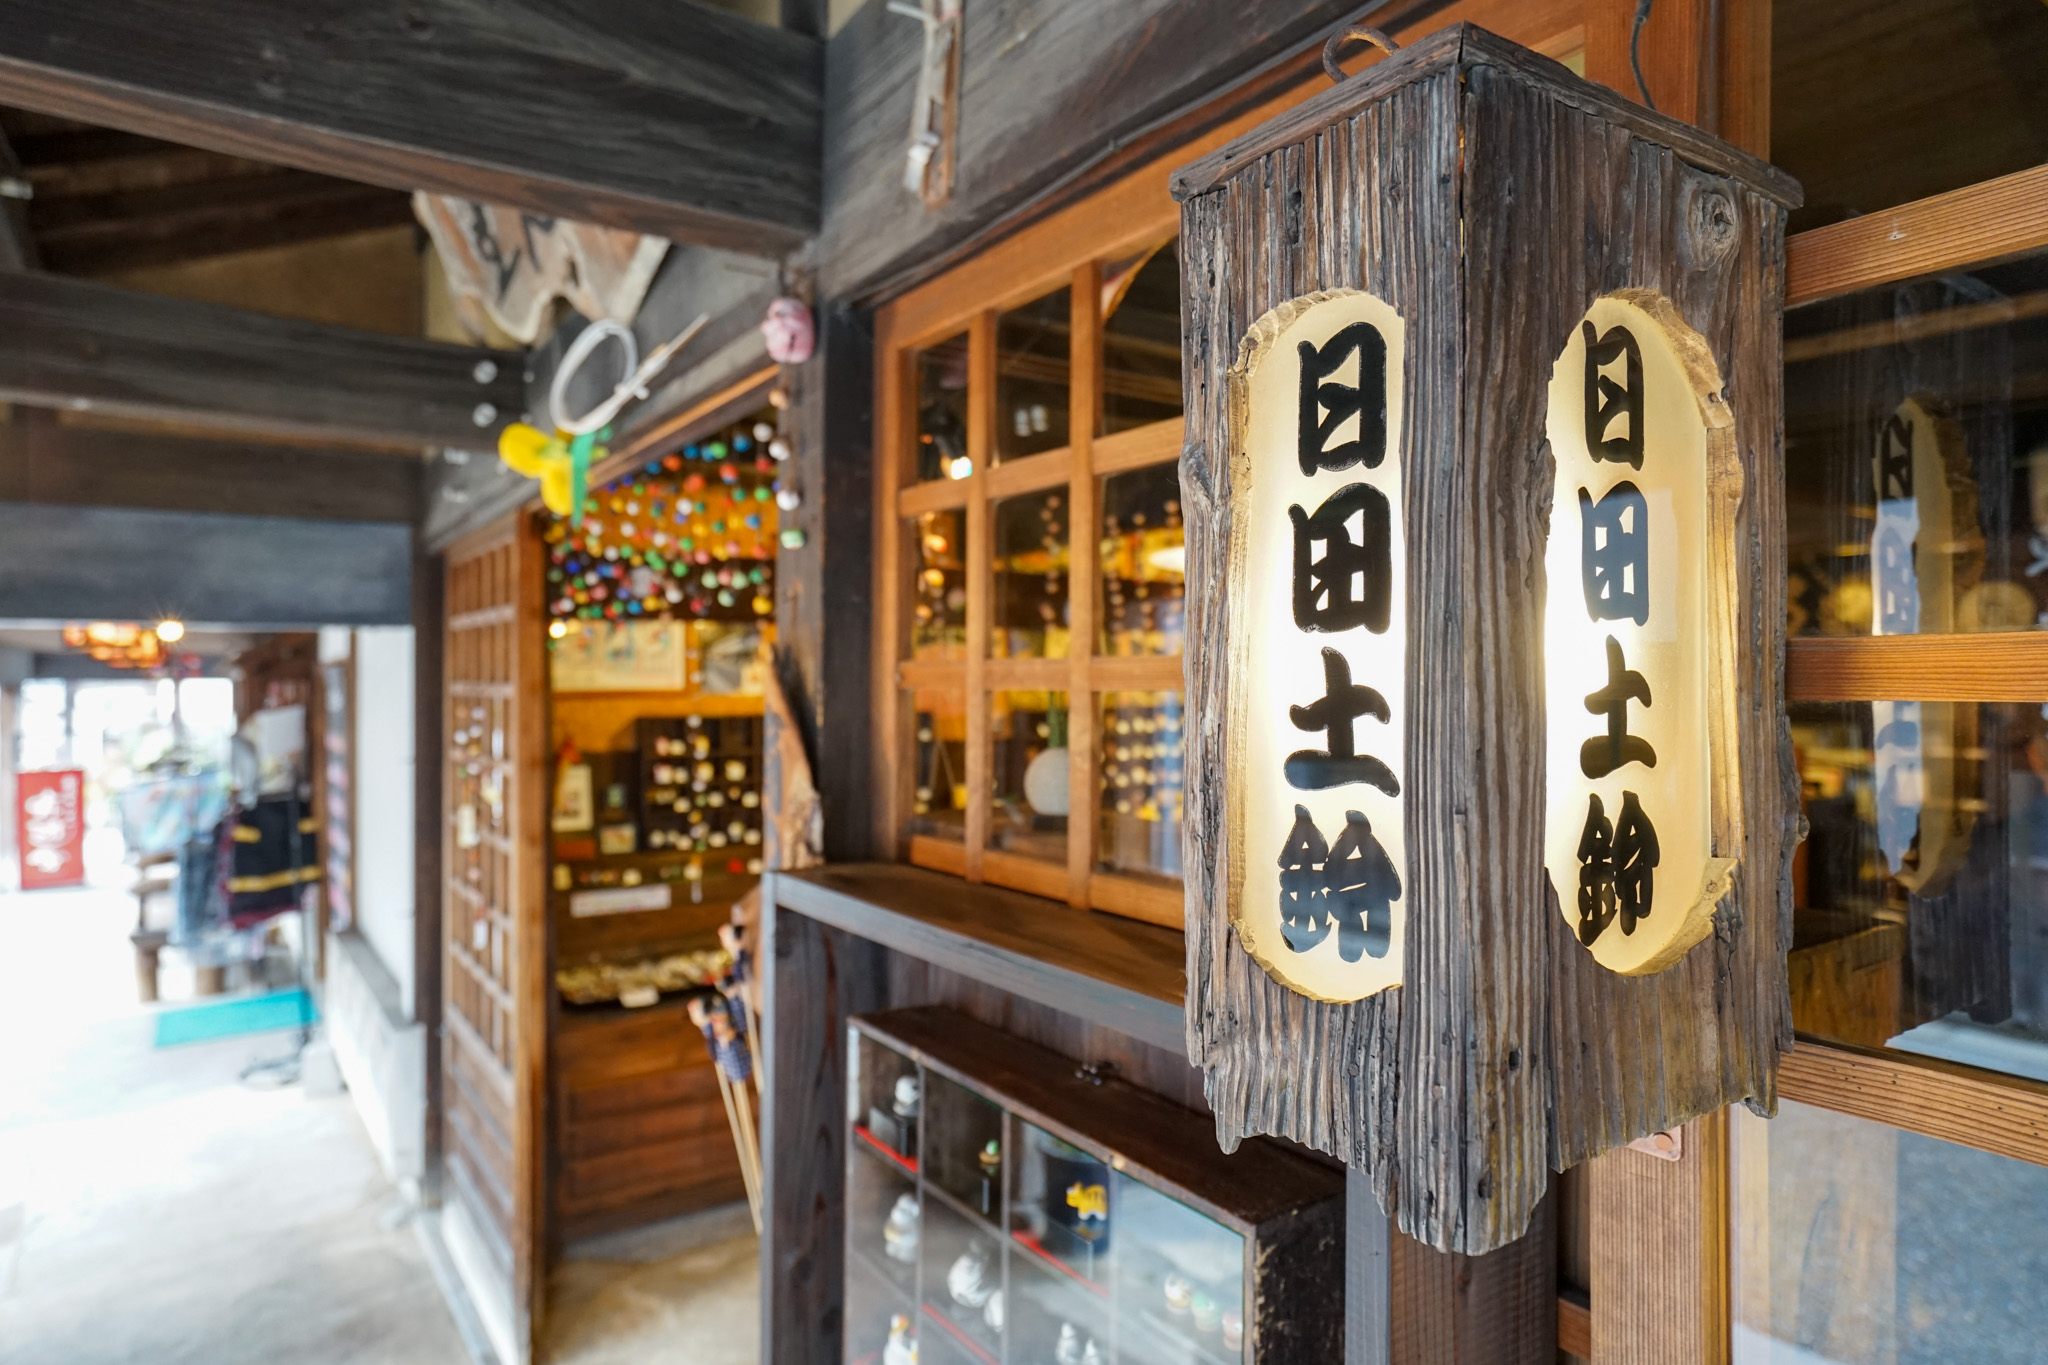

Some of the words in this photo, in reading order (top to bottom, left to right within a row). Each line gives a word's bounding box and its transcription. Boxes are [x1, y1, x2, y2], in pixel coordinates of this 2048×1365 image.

[1278, 321, 1401, 963] 日田土鈴
[1577, 319, 1659, 946] 日田土鈴
